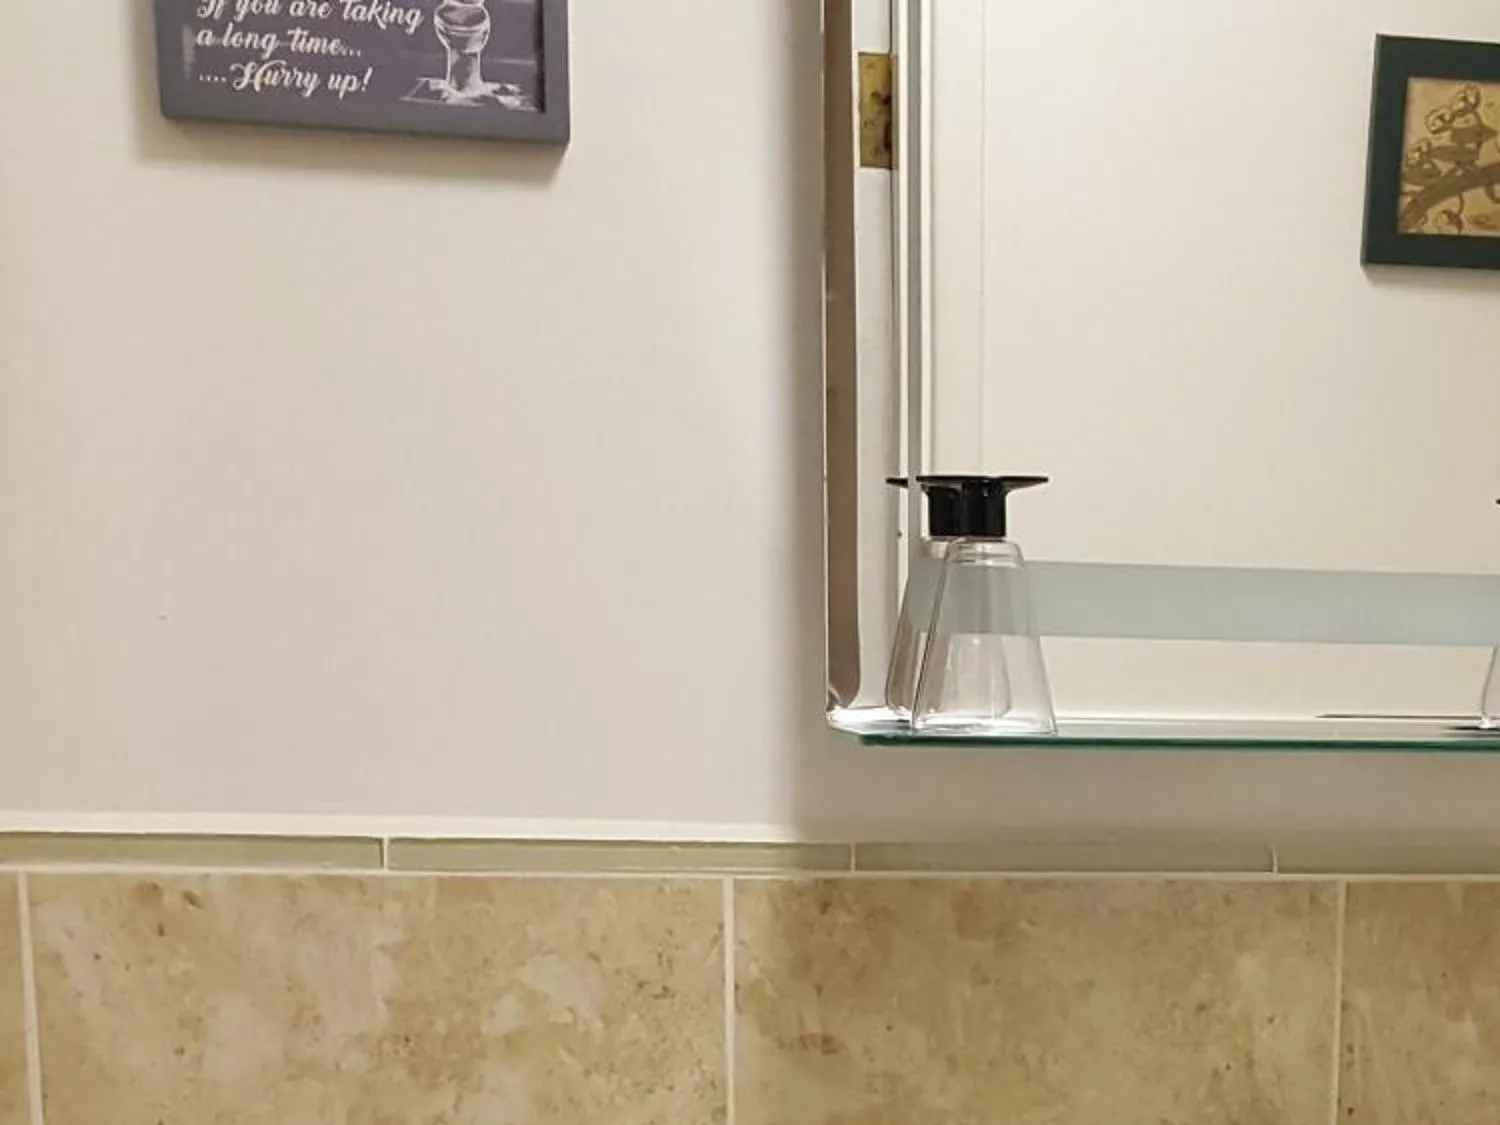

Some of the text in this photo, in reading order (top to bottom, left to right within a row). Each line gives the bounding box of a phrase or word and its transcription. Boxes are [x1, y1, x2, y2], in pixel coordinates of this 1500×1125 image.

[233, 0, 281, 22] you
[288, 0, 333, 18] are
[196, 29, 215, 46] a
[221, 22, 280, 59] long
[327, 66, 373, 99] up!
